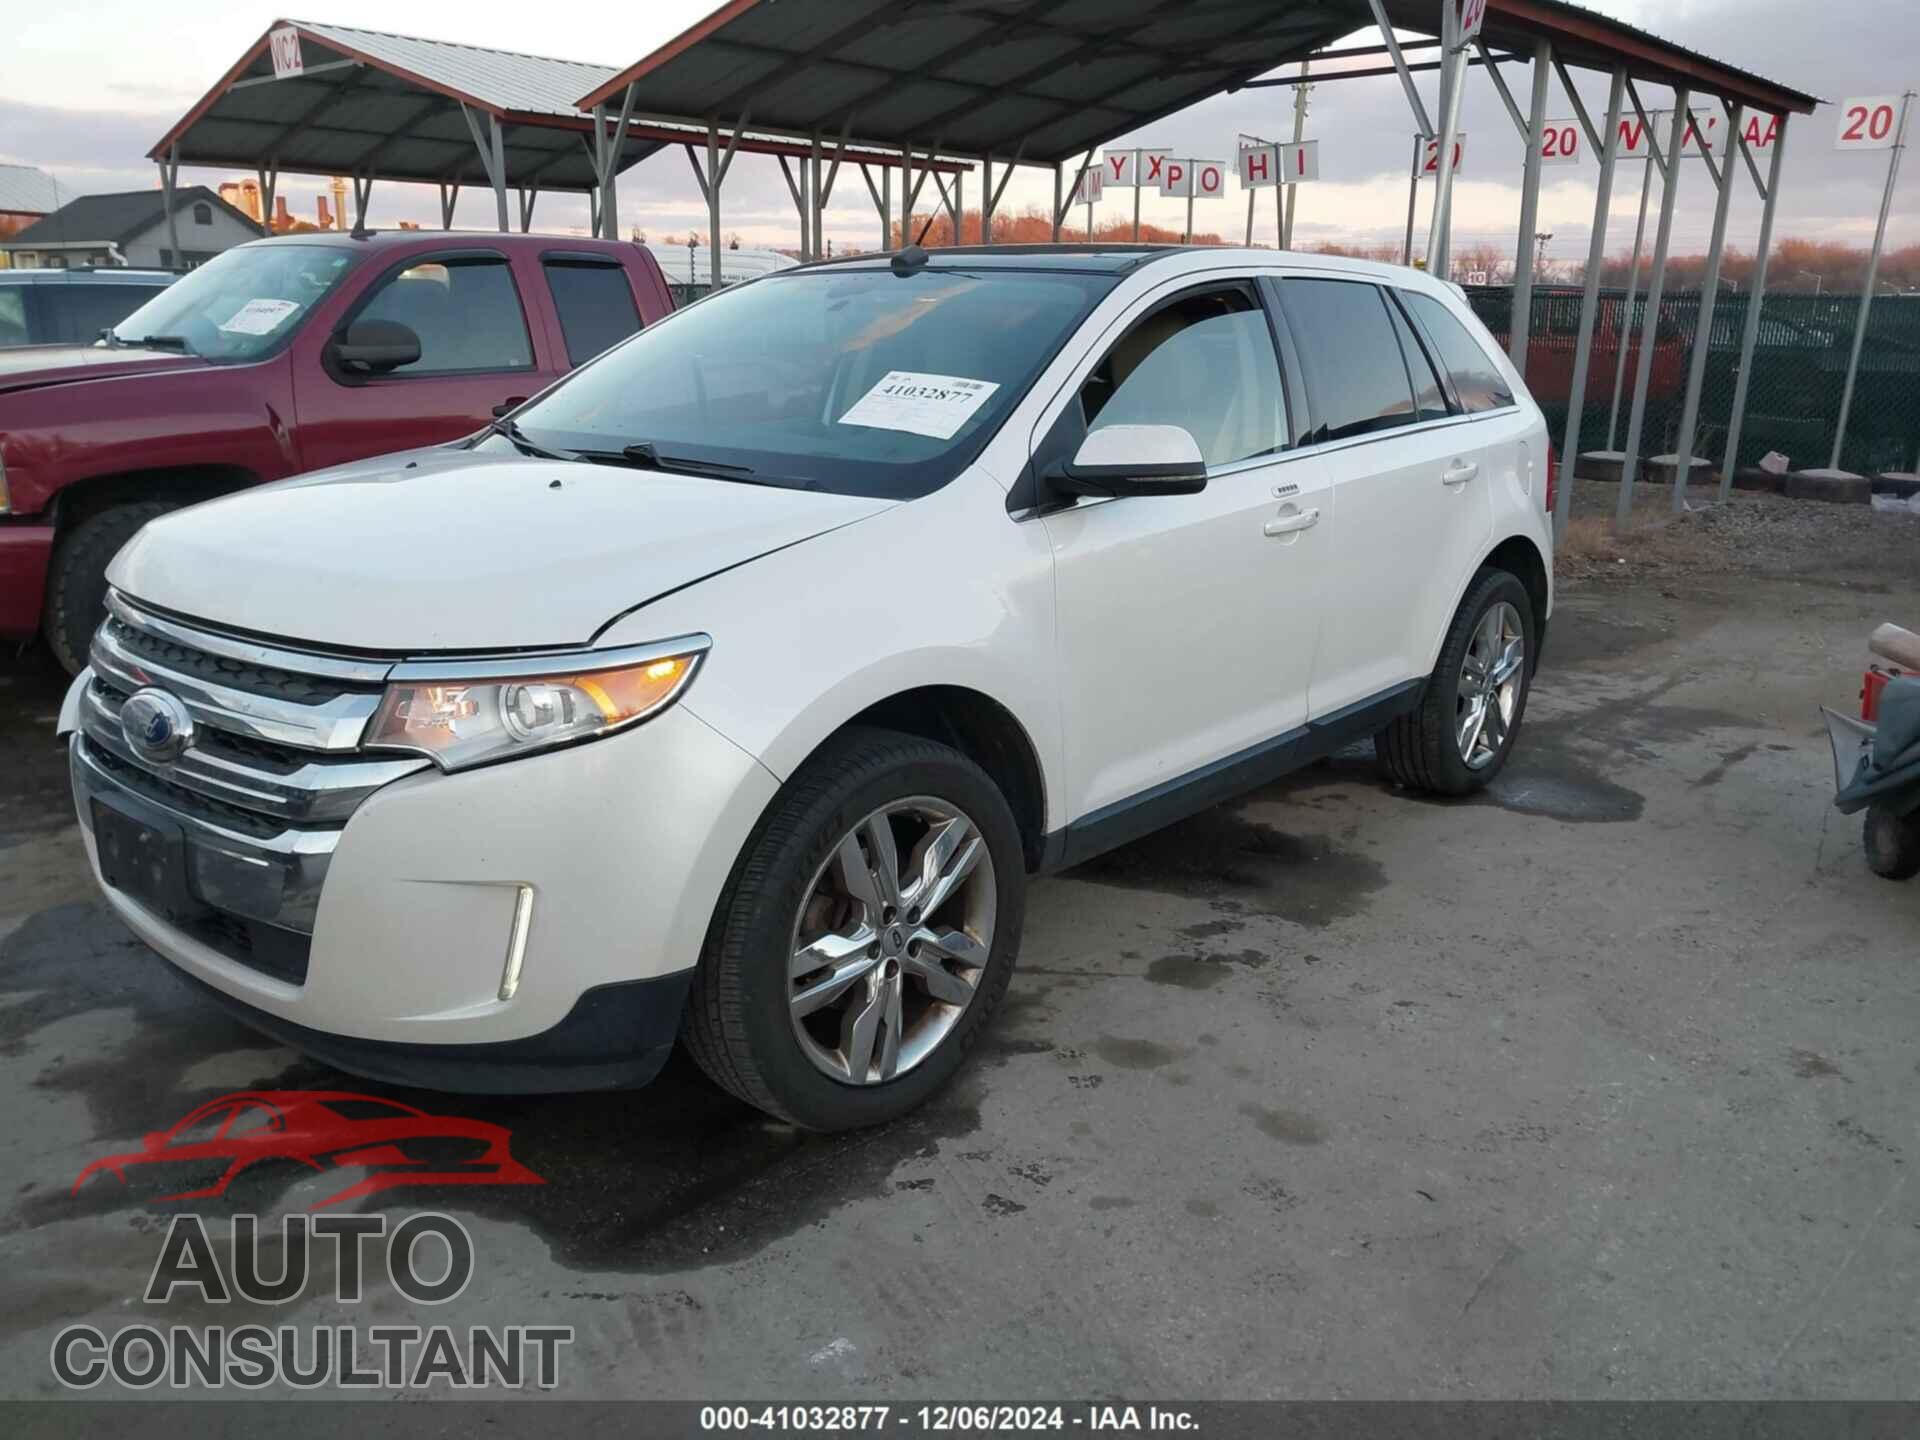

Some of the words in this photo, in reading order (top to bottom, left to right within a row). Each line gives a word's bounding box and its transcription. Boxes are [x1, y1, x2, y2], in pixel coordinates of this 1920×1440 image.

[1841, 104, 1893, 141] 20
[1541, 127, 1578, 157] 20
[1110, 156, 1126, 180] Y
[1148, 156, 1164, 180] X
[1167, 165, 1183, 190] P
[1248, 154, 1267, 181] H
[883, 384, 973, 403] 41032877
